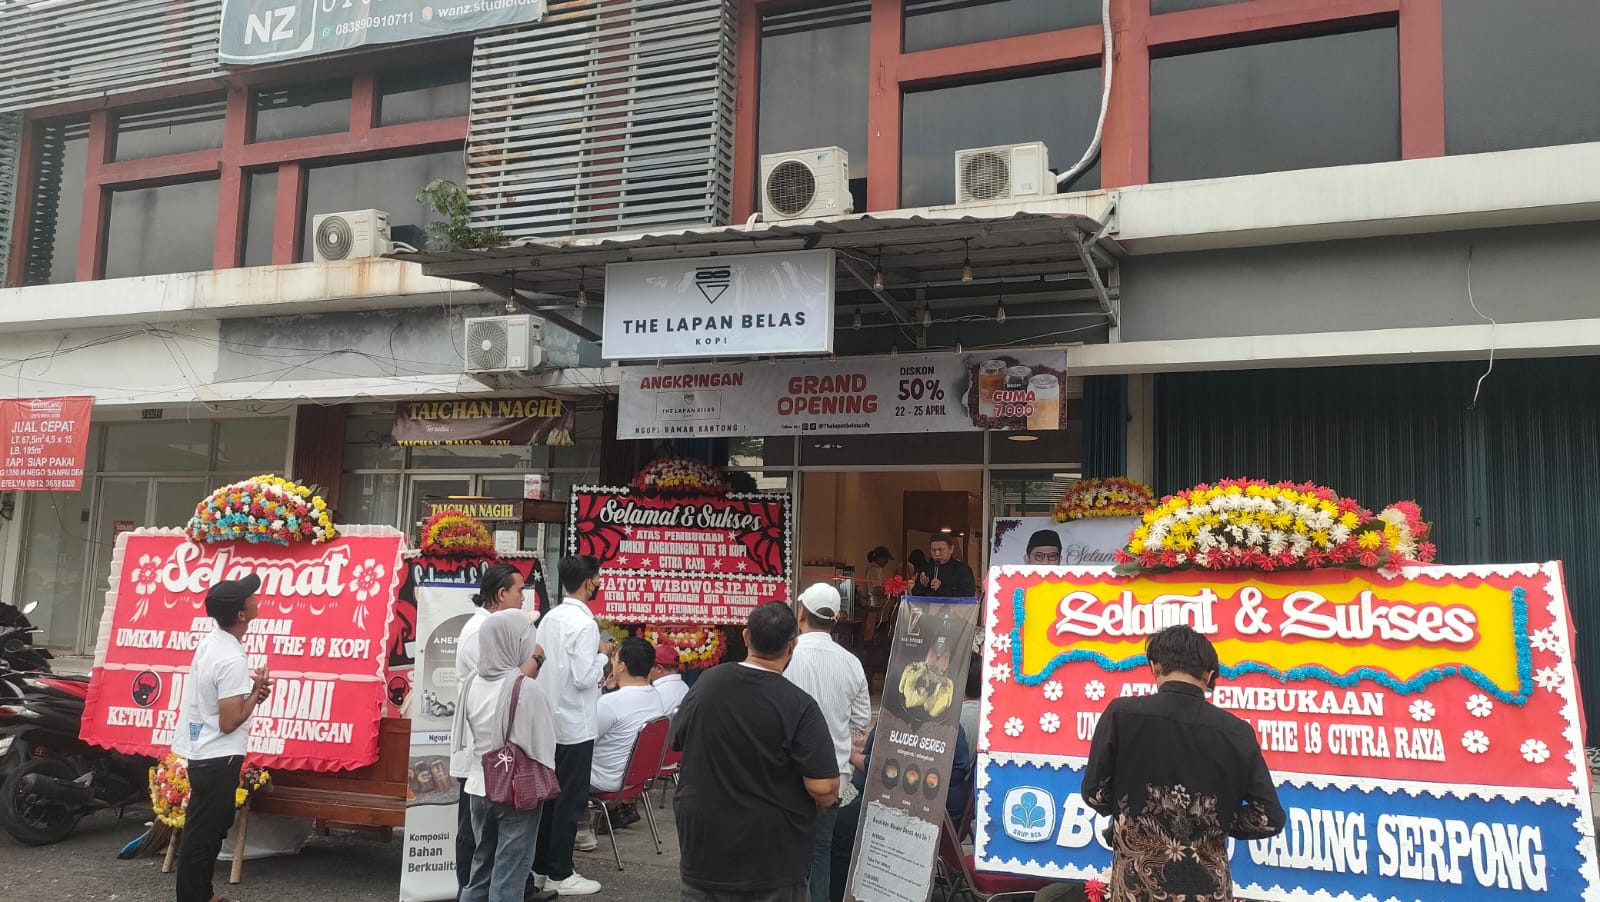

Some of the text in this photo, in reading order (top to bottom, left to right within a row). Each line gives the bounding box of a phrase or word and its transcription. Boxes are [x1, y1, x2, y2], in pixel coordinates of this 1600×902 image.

[243, 6, 294, 45] NZ
[335, 11, 414, 36] 083890910711
[623, 311, 806, 334] THE LAPAN BELAS
[695, 337, 727, 345] KOPI
[900, 366, 934, 376] DISKON
[640, 372, 744, 390] ANGKRINGAN
[788, 373, 867, 395] GRAND
[897, 378, 944, 401] 50%
[408, 399, 562, 420] TAICHAN NAGIH
[777, 395, 878, 416] OPENING
[895, 406, 905, 416] 22
[913, 406, 924, 416] 25
[925, 404, 947, 416] APRIL
[11, 420, 75, 433] JUAL CEPAT
[698, 424, 738, 432] KANTONG
[64, 435, 73, 443] 15
[27, 457, 48, 467] SIAP
[49, 457, 75, 466] PAKAI
[479, 504, 514, 517] NAGIH
[599, 499, 762, 532] Selamat & Sukses
[637, 530, 724, 543] ATAS PEMBUKAAN
[619, 540, 747, 557] UMKM ANGKRINGAN THE 18 KOPI
[659, 557, 706, 570] CITRA RAYA
[604, 591, 625, 601] KETUA
[605, 602, 627, 612] KETUA
[1056, 586, 1477, 643] Selamat & Sukses
[116, 628, 164, 651] UMKM
[272, 633, 306, 657] THE
[309, 637, 324, 658] 18
[327, 637, 371, 659] KOPI
[1204, 685, 1384, 717] EMBUKAAN
[107, 706, 153, 727] KETUA
[428, 734, 448, 743] Ngopi
[889, 730, 946, 754] BLUDER SERIES
[1258, 719, 1298, 754] THE
[1304, 721, 1323, 755] 18
[1327, 723, 1391, 759] CITRA
[1393, 726, 1446, 763] RAYA
[409, 831, 450, 842] Komposisi
[409, 846, 443, 858] Bahan
[1377, 812, 1548, 893] SERPONG
